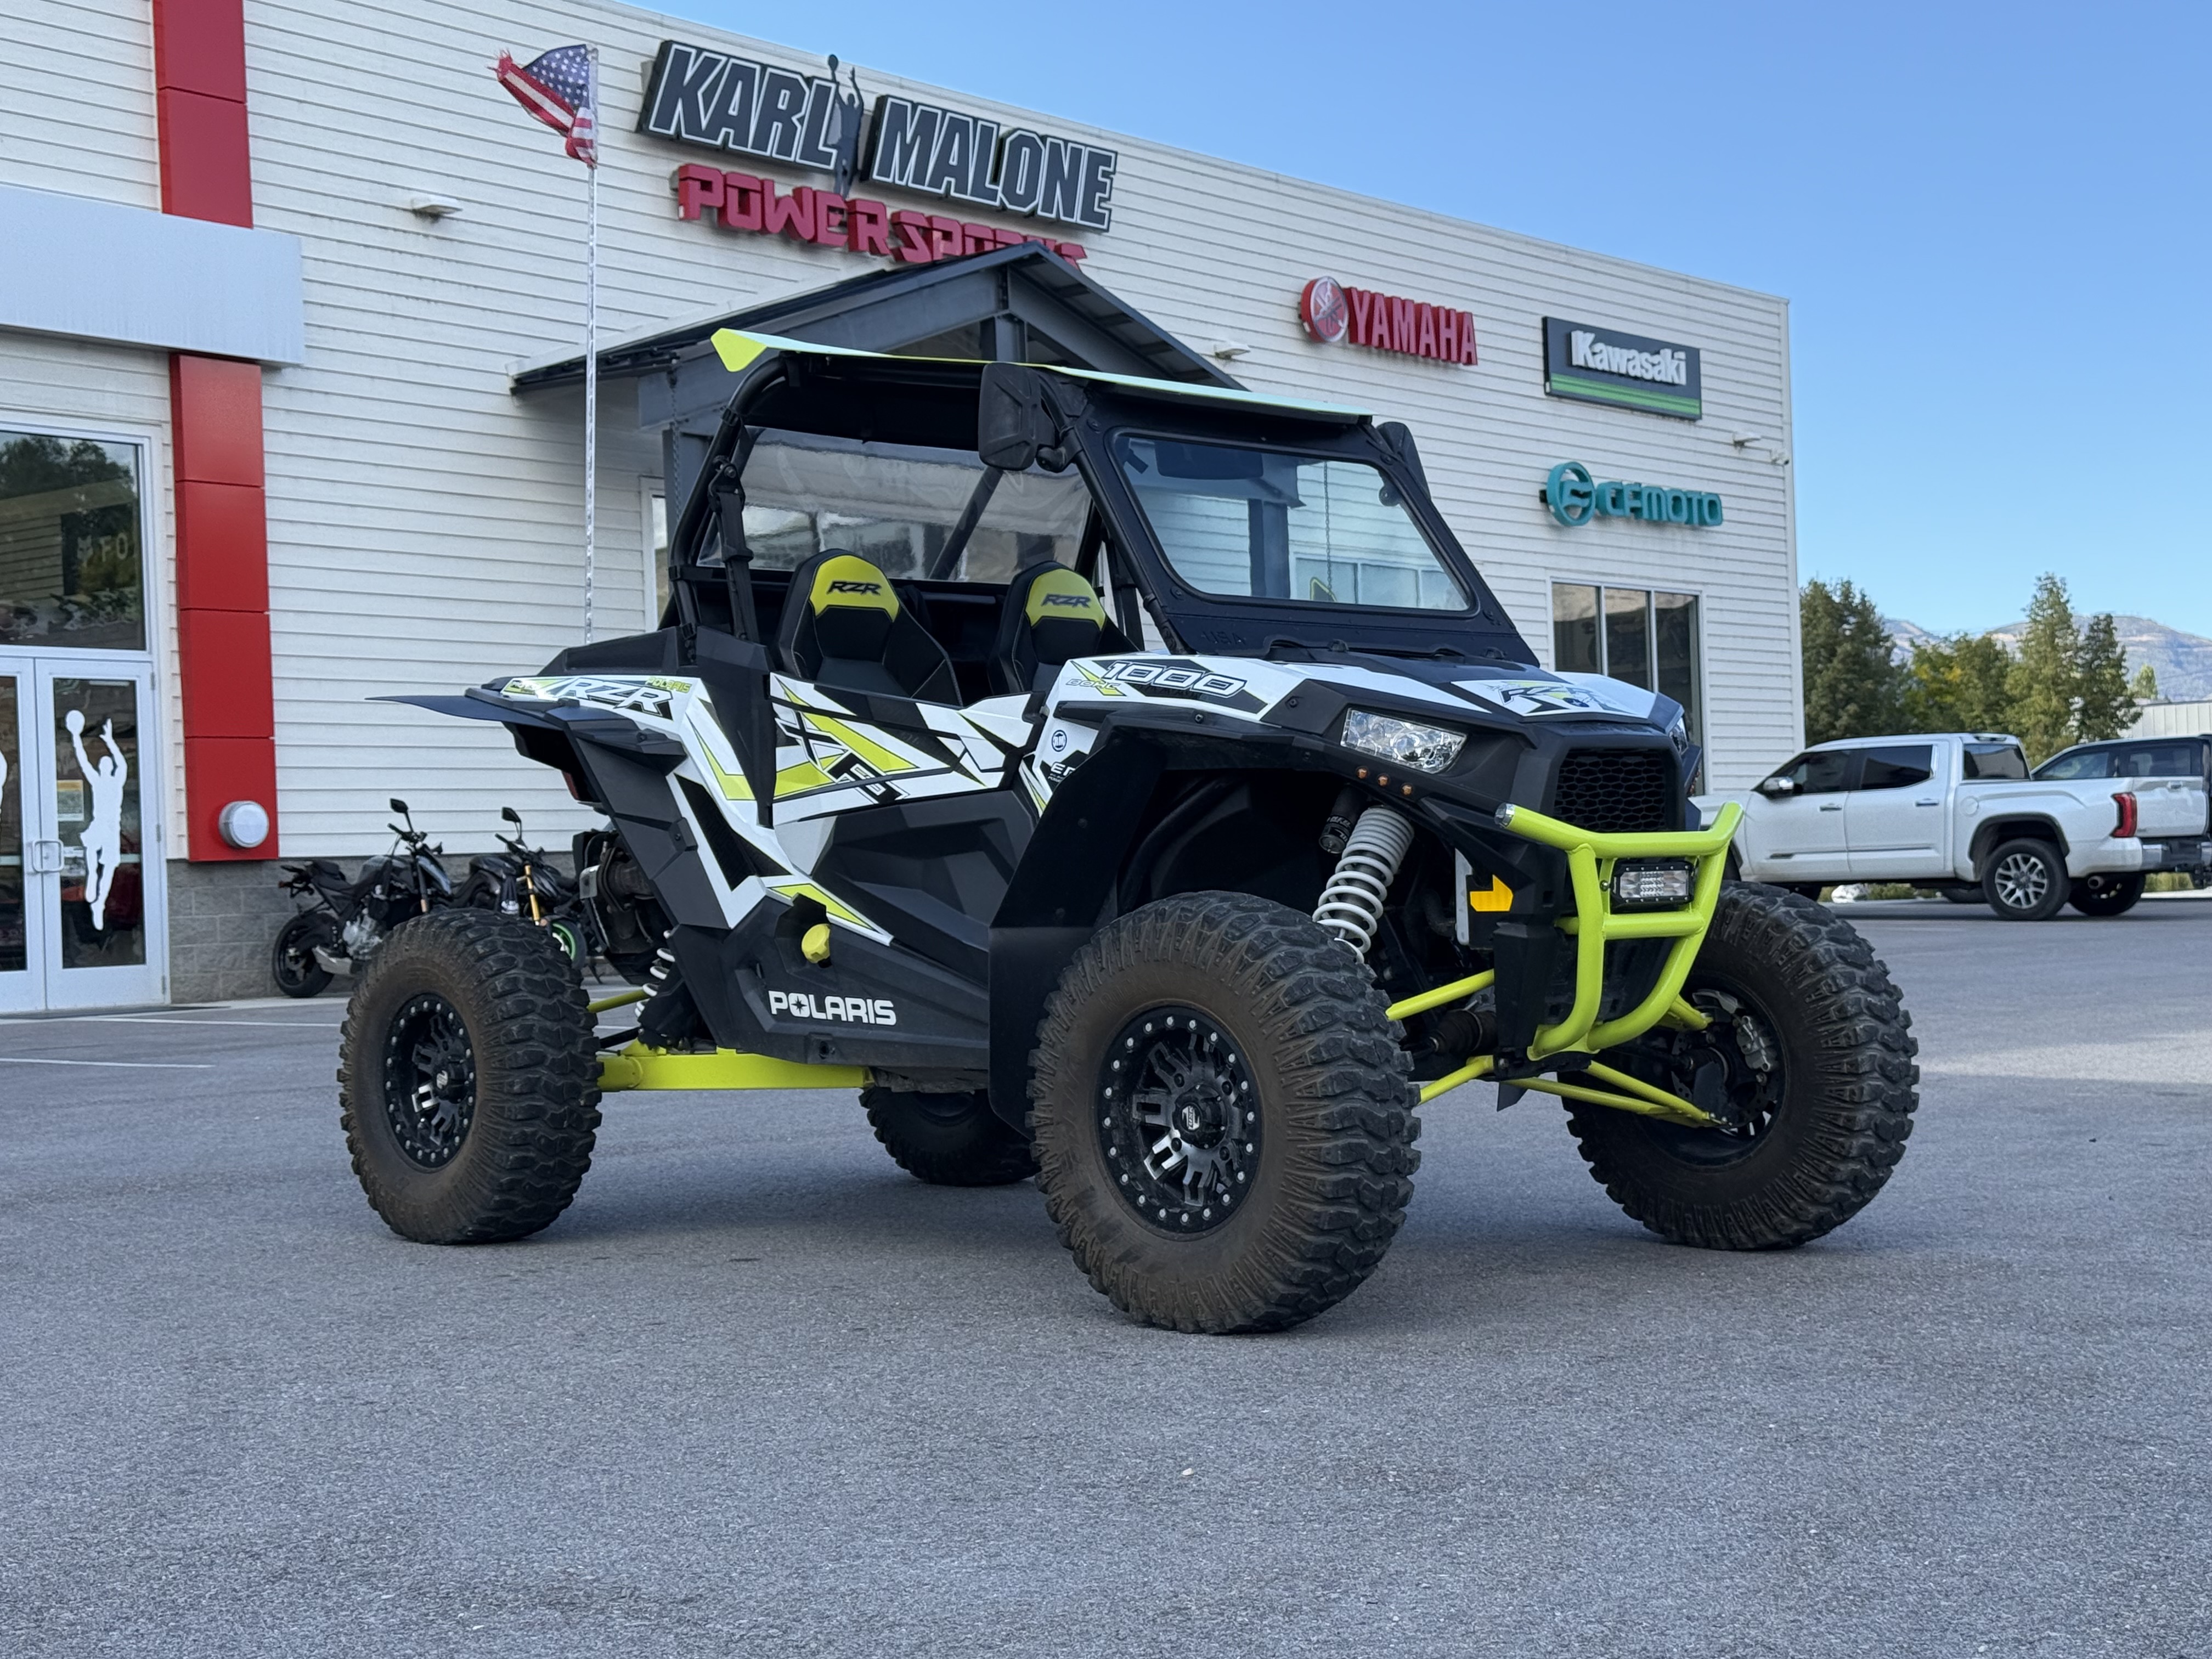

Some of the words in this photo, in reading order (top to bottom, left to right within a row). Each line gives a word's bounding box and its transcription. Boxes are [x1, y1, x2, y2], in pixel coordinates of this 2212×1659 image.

[647, 43, 839, 171] KARL
[872, 95, 1117, 232] MALONE
[679, 163, 1087, 268] POWERSPO
[1347, 286, 1478, 366] YAMAHA
[1569, 329, 1686, 386] Kawasaki
[1595, 481, 1723, 527] CFMOTO
[827, 581, 882, 596] RZR
[1042, 594, 1091, 608] RZR
[557, 677, 674, 716] RZR
[646, 676, 692, 693] POLARIS
[1102, 660, 1248, 698] 1000
[769, 990, 897, 1025] POLARIS
